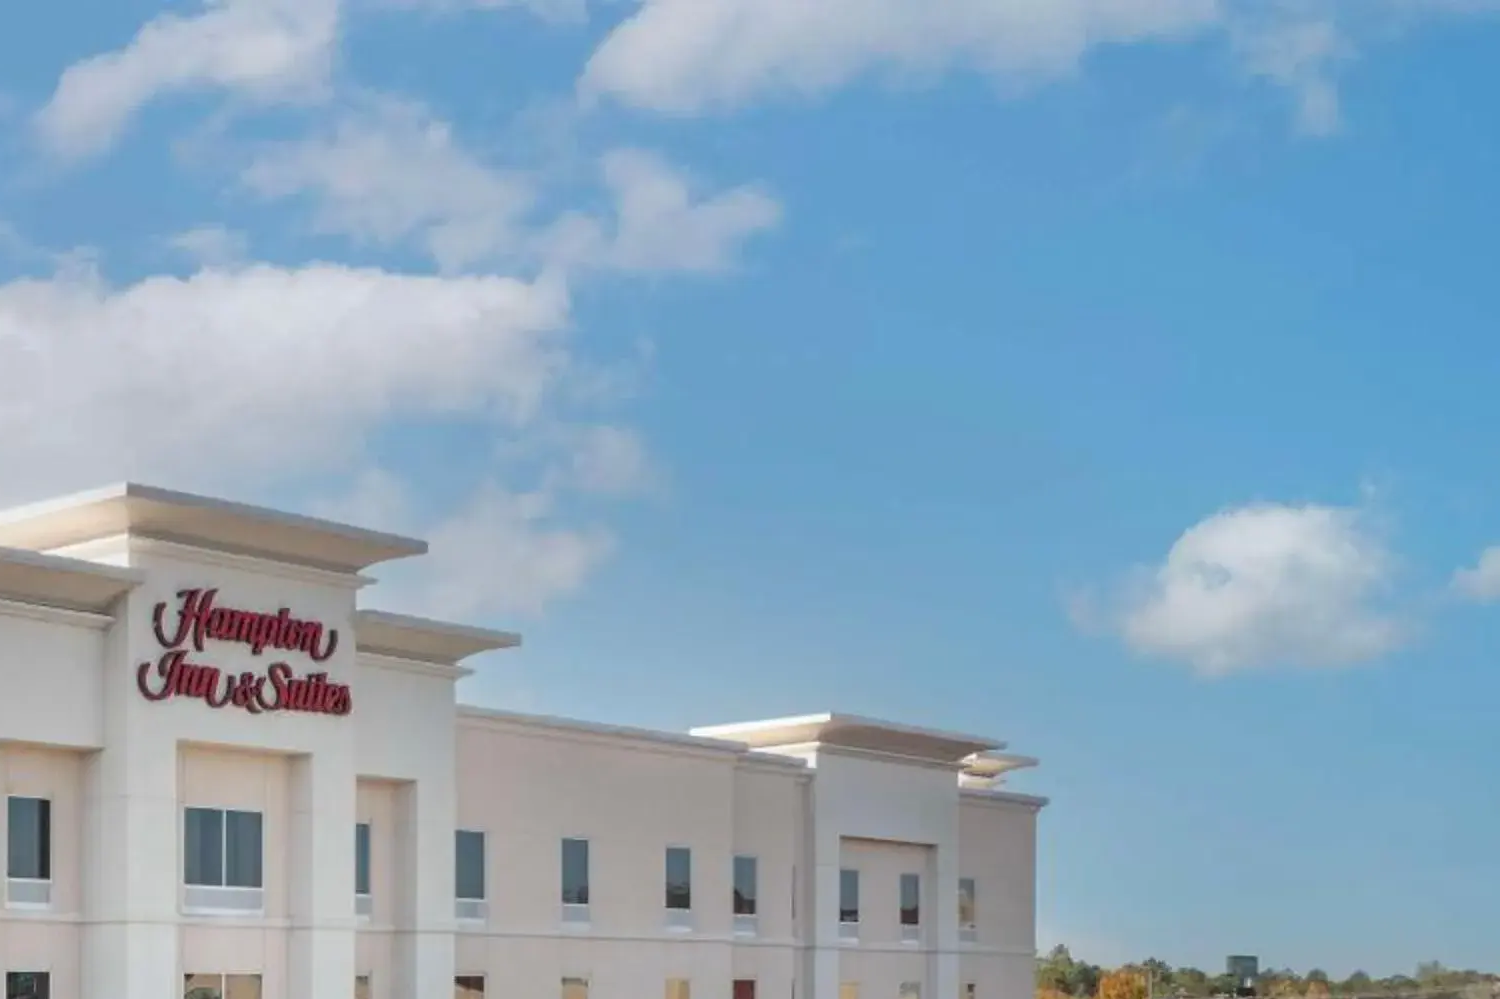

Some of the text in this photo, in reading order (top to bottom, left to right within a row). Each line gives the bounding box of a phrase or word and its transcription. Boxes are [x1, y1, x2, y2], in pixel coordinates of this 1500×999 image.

[153, 588, 338, 661] Hampton
[137, 650, 352, 715] Inn & Suites
